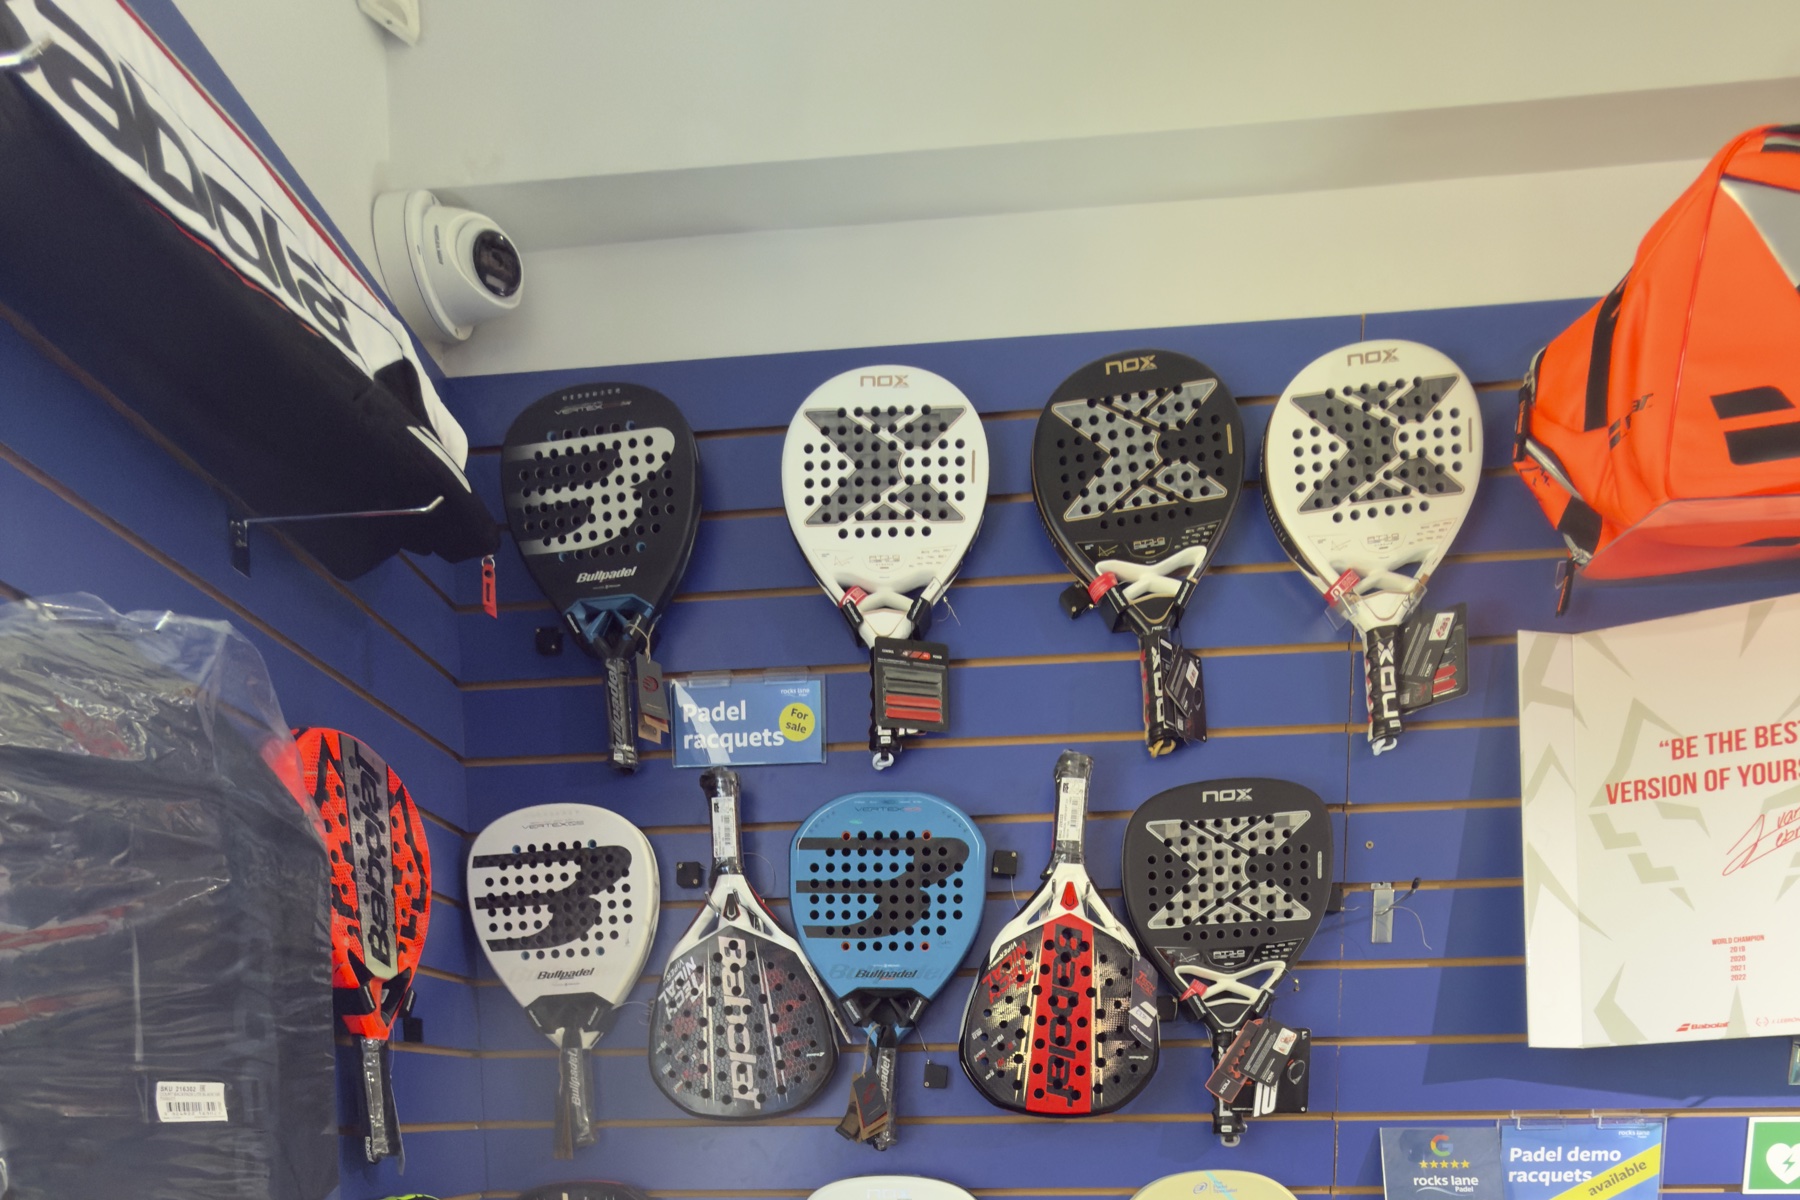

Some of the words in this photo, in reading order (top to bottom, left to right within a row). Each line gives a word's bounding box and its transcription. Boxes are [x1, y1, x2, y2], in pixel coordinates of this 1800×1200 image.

[576, 566, 638, 584] Bullpadel
[683, 700, 747, 723] Padel
[790, 708, 809, 721] For
[786, 722, 807, 735] sale
[1704, 728, 1748, 756] THE
[1754, 719, 1800, 749] BES
[684, 728, 785, 754] racquets
[1605, 771, 1698, 805] VERSION
[1704, 767, 1731, 792] OF
[355, 741, 393, 969] Babolat
[1733, 934, 1765, 943] CHAMPION
[537, 967, 595, 980] Bullpadel
[855, 969, 918, 982] Bullpadel
[1730, 964, 1746, 972] 2021
[717, 935, 762, 1110] Babolat
[1046, 923, 1083, 1107] Babolat
[1690, 1021, 1730, 1030] Babolat
[567, 1048, 582, 1107] Bullpadel
[1509, 1146, 1563, 1162] Padel
[1567, 1146, 1622, 1162] demo
[1413, 1175, 1449, 1186] rocks
[1451, 1175, 1479, 1186] lane
[1508, 1168, 1593, 1187] racquets
[1588, 1160, 1648, 1197] available
